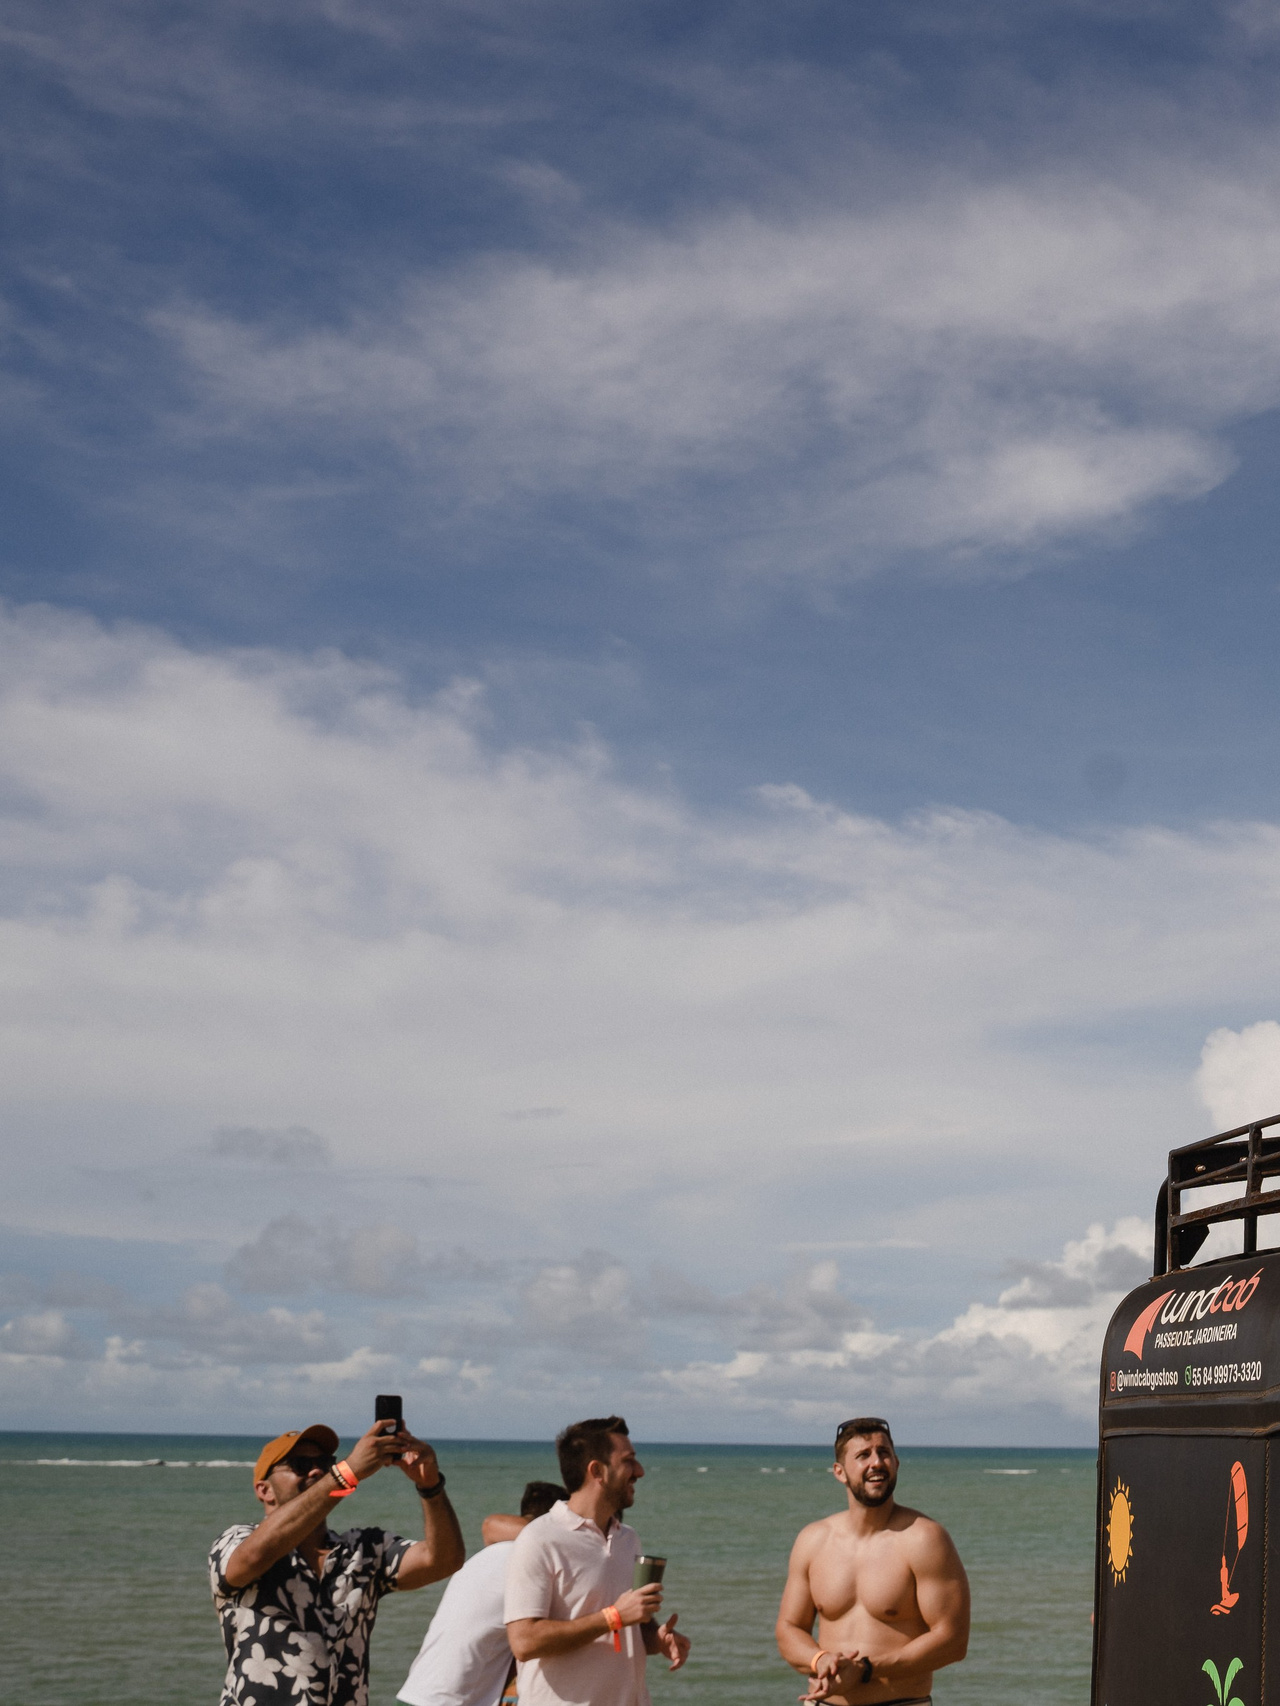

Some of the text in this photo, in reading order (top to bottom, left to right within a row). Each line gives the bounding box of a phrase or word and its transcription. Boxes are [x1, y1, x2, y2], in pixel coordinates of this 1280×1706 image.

[1154, 1323, 1238, 1348] PASSEIO DE JARDINEIRA
[1117, 1360, 1262, 1392] @windcabgostoso 55 84 99973-3320
